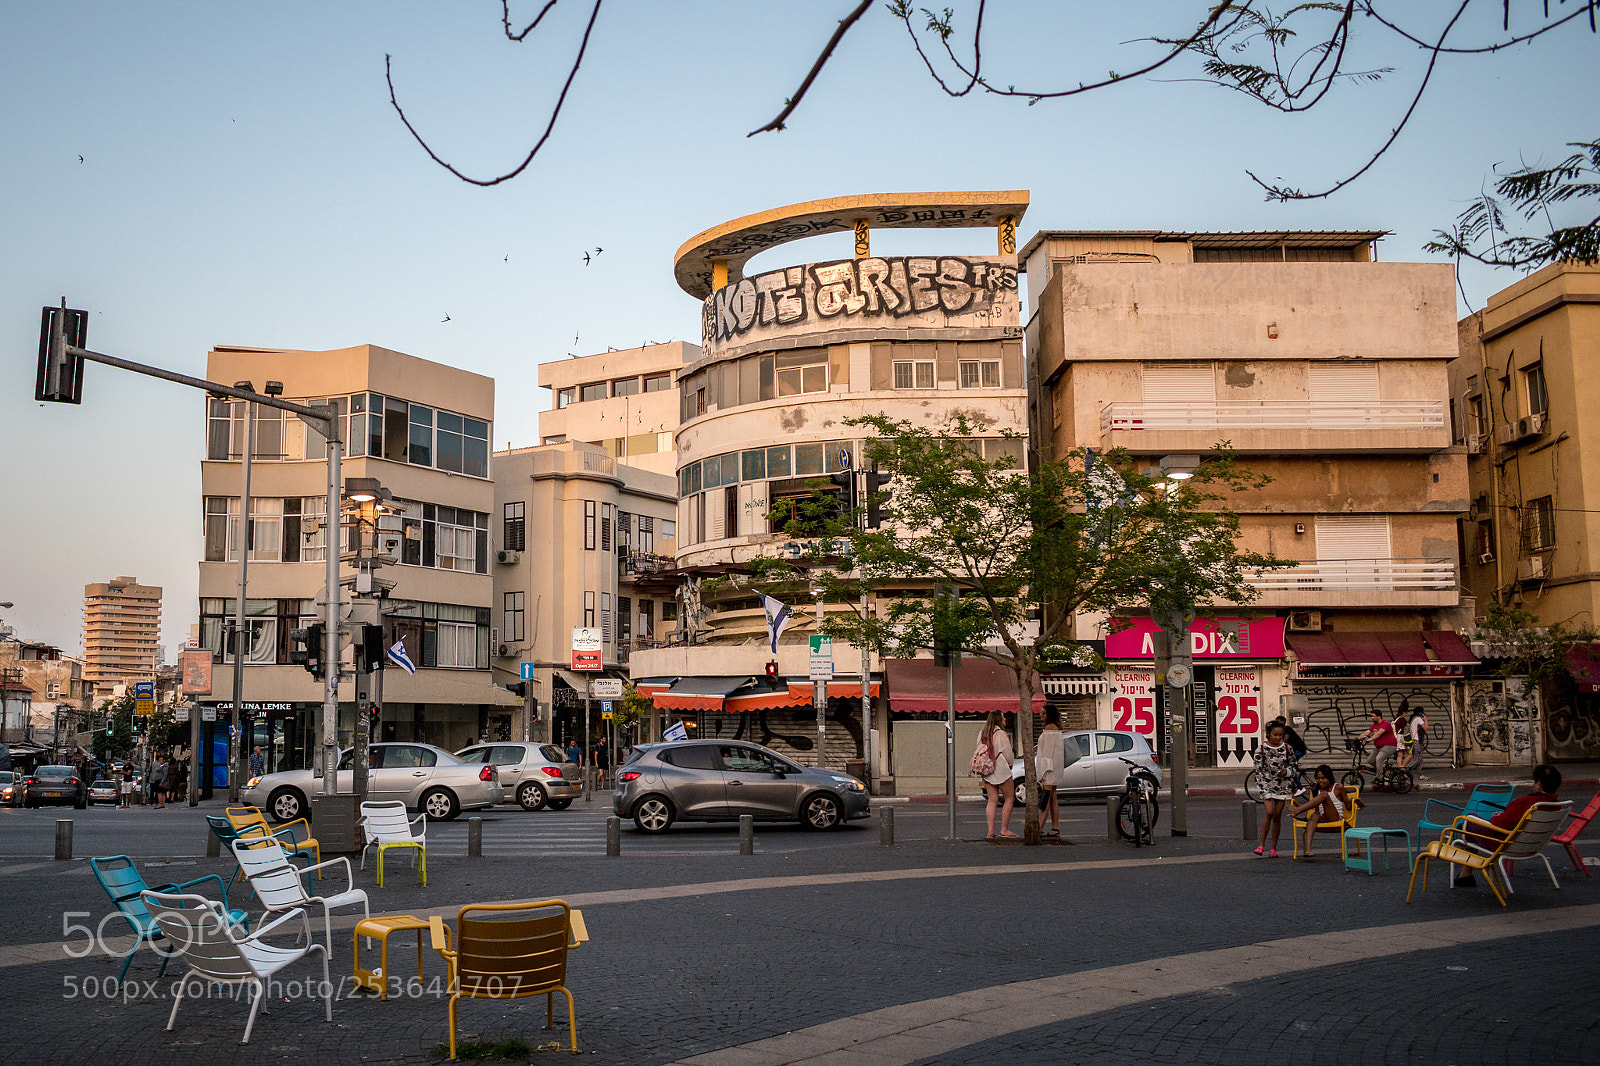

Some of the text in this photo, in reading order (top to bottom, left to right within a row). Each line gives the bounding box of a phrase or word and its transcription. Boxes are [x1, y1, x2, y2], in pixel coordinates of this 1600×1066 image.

[1141, 632, 1235, 654] MDIX
[1115, 673, 1151, 682] CLEARING
[1219, 672, 1255, 681] CLEARING
[1120, 684, 1145, 695] חיסול
[1225, 683, 1250, 694] חיסול
[1113, 697, 1154, 735] 25
[1218, 695, 1260, 734] 25
